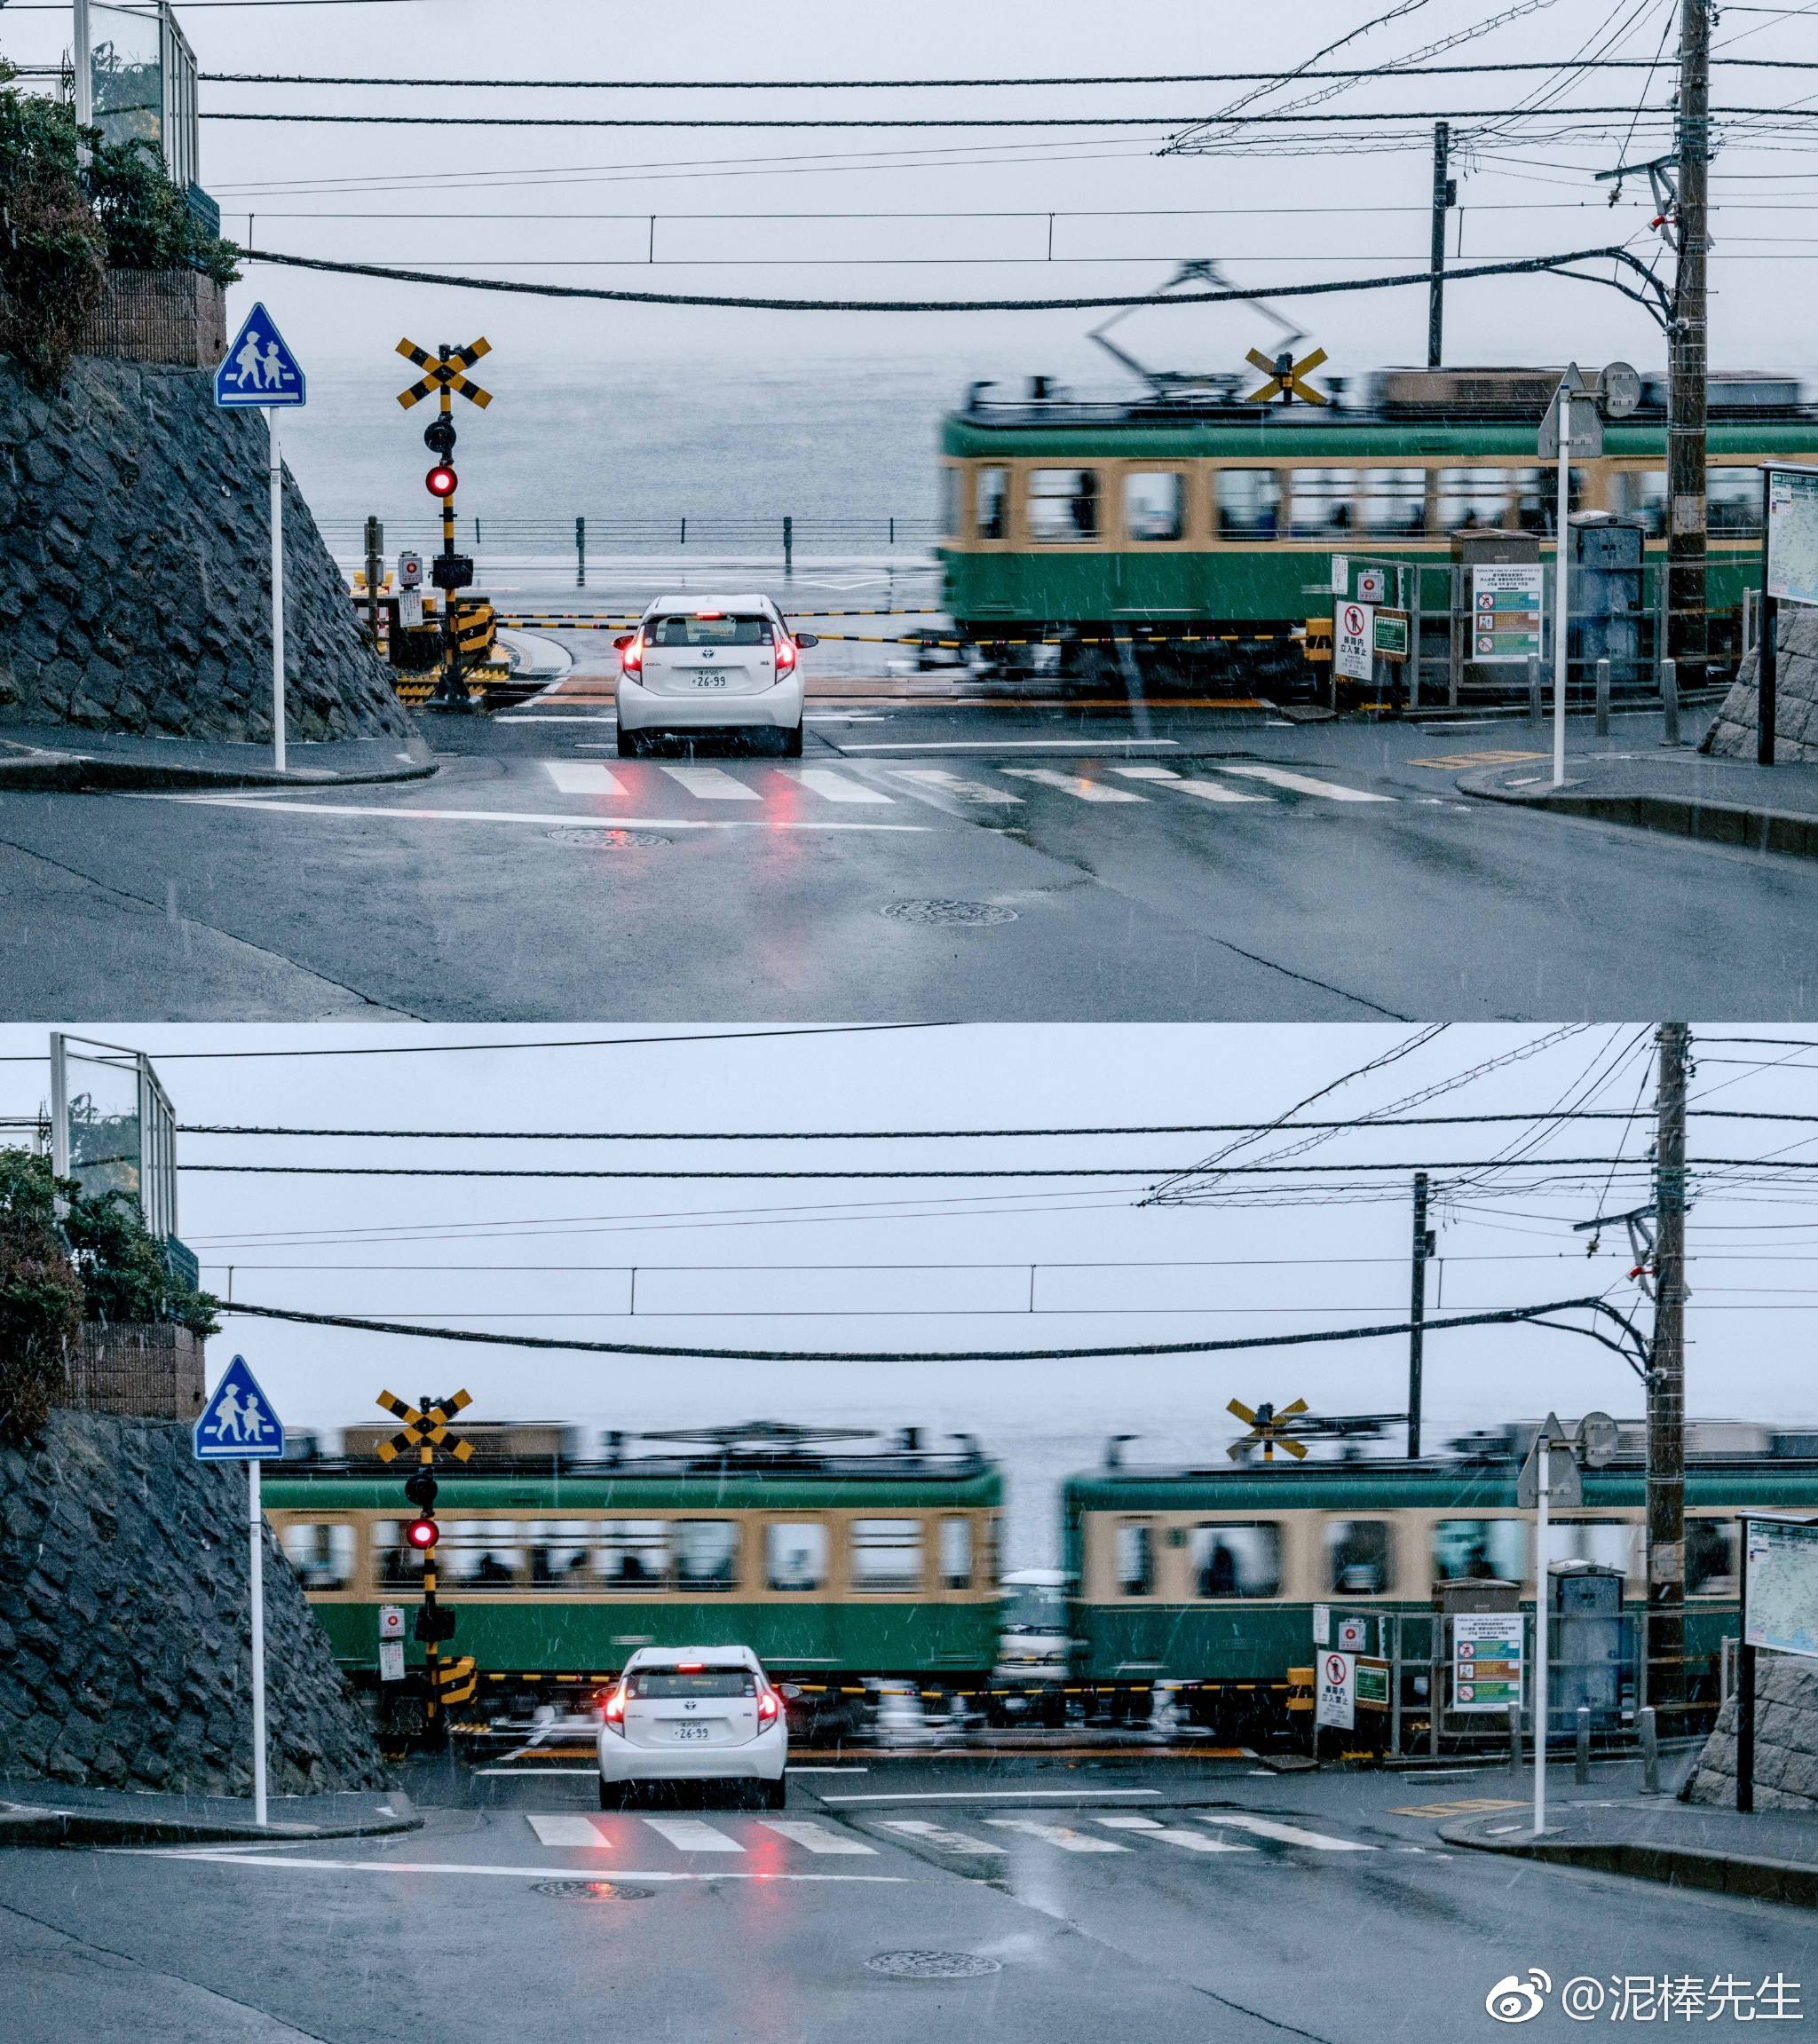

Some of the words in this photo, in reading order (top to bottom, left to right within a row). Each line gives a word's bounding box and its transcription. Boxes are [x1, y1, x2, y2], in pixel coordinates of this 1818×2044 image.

[1344, 635, 1364, 646] 線路内
[1340, 644, 1367, 657] 立入禁止
[698, 676, 725, 687] 26-99
[680, 1728, 708, 1739] 26-99
